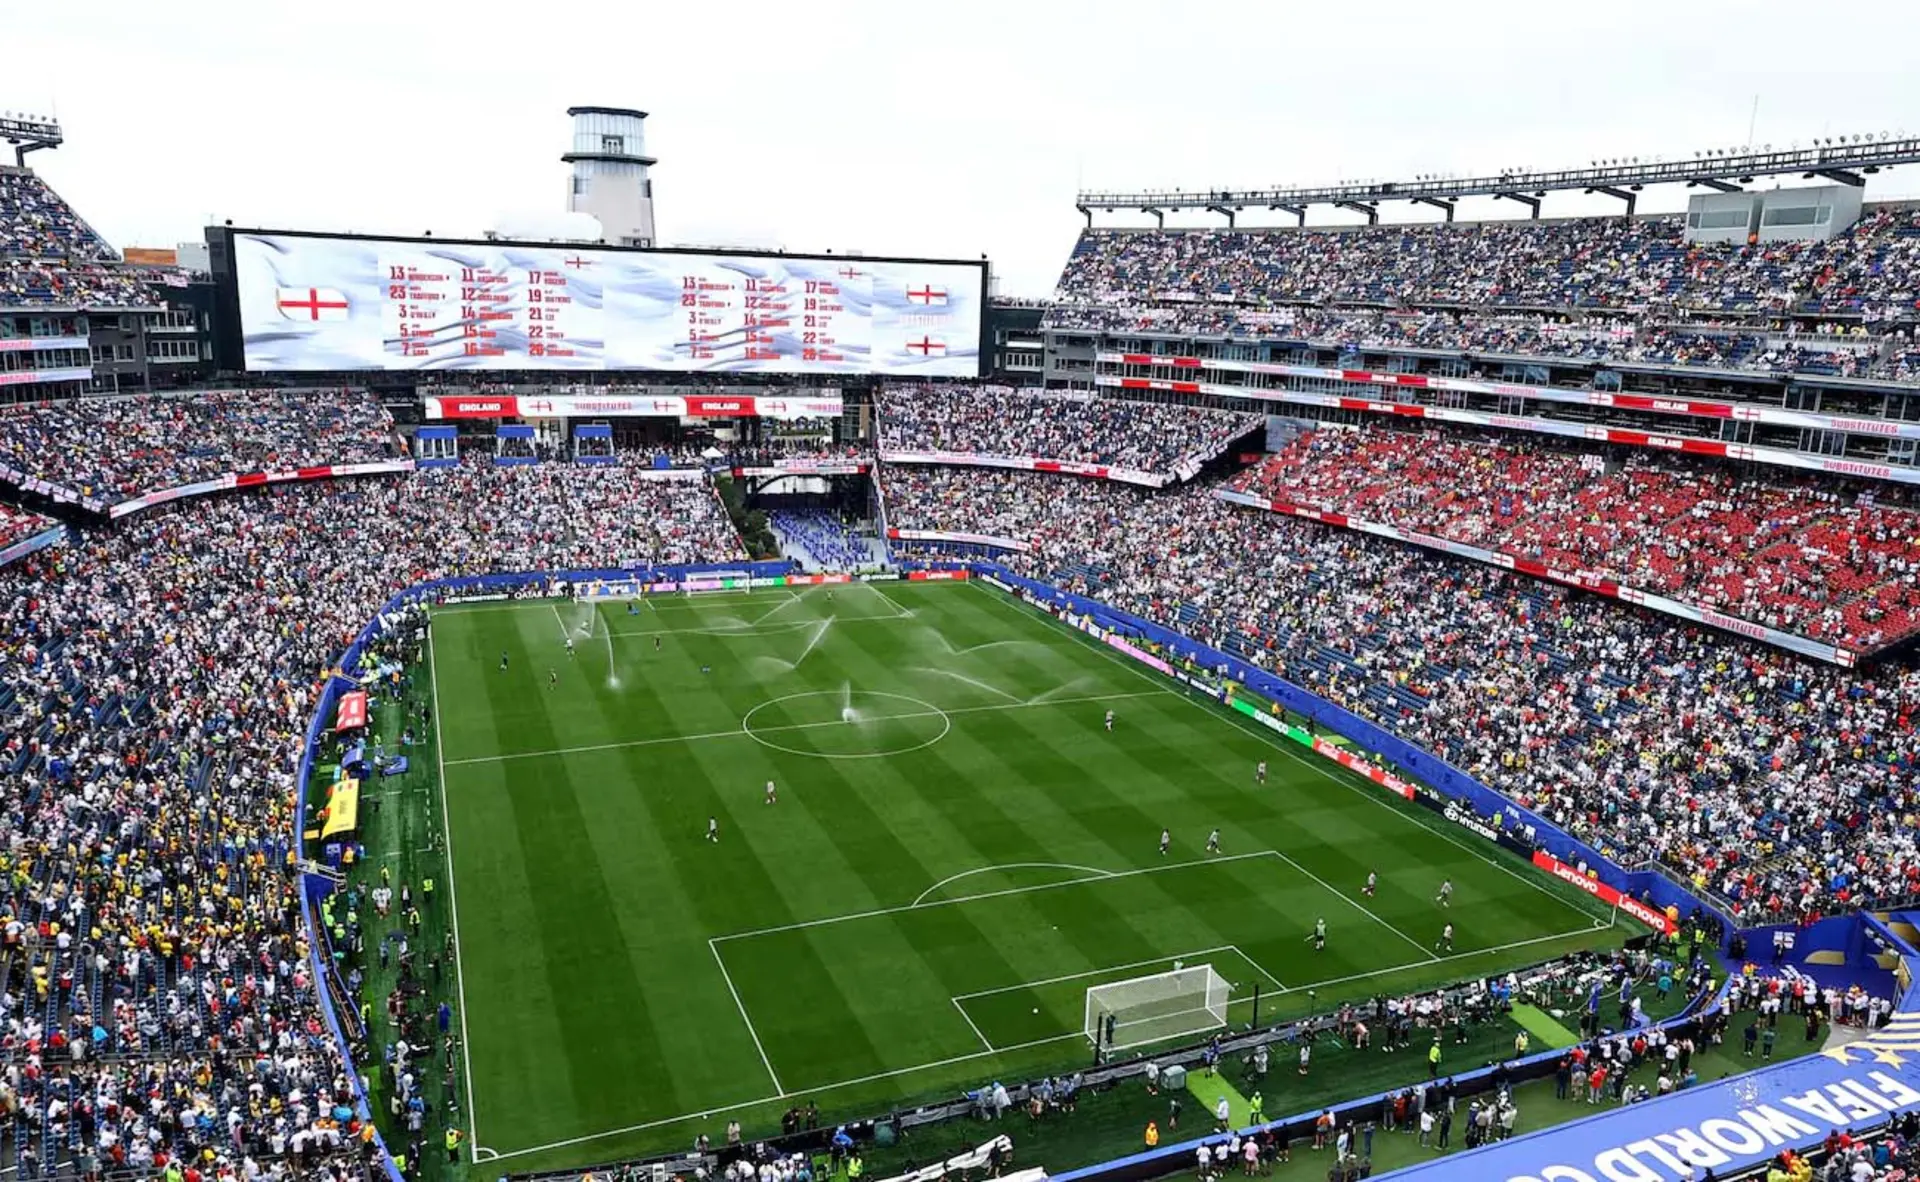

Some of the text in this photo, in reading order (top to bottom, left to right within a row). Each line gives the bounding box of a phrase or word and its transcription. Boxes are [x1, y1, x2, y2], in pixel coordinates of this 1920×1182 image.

[390, 266, 404, 280] 13
[462, 268, 474, 282] 11
[529, 271, 541, 284] 17
[683, 277, 696, 289] 13
[746, 279, 757, 291] 11
[805, 281, 817, 293] 17
[390, 285, 406, 299] 23
[461, 287, 476, 301] 12
[528, 289, 542, 302] 19
[682, 294, 696, 307] 23
[745, 296, 758, 309] 12
[804, 298, 816, 310] 19
[398, 304, 407, 318] 3
[461, 306, 476, 319] 14
[529, 307, 542, 320] 21
[689, 311, 697, 324] 3
[744, 313, 757, 326] 14
[804, 315, 816, 327] 21
[400, 323, 408, 337] 5
[464, 325, 477, 338] 15
[528, 325, 543, 338] 22
[689, 328, 697, 341] 5
[745, 331, 757, 343] 15
[803, 332, 816, 344] 22
[402, 342, 409, 355] 7
[459, 403, 501, 412] ENGLAND
[702, 402, 741, 410] ENGLAND
[1653, 400, 1689, 412] ENGLAND
[1831, 419, 1898, 434] SUBSTITUTES
[1647, 436, 1683, 449] ENGLAND
[1823, 460, 1890, 477] SUBSTITUTES
[514, 590, 542, 600] QATAR
[1702, 612, 1765, 638] SUBSTITUTES
[1254, 709, 1289, 735] aramco
[1458, 815, 1498, 842] HYUNDAI
[1553, 861, 1599, 894] Lenovo
[1618, 893, 1666, 930] Lenovo
[1594, 1070, 1920, 1182] FIFA WORLD
